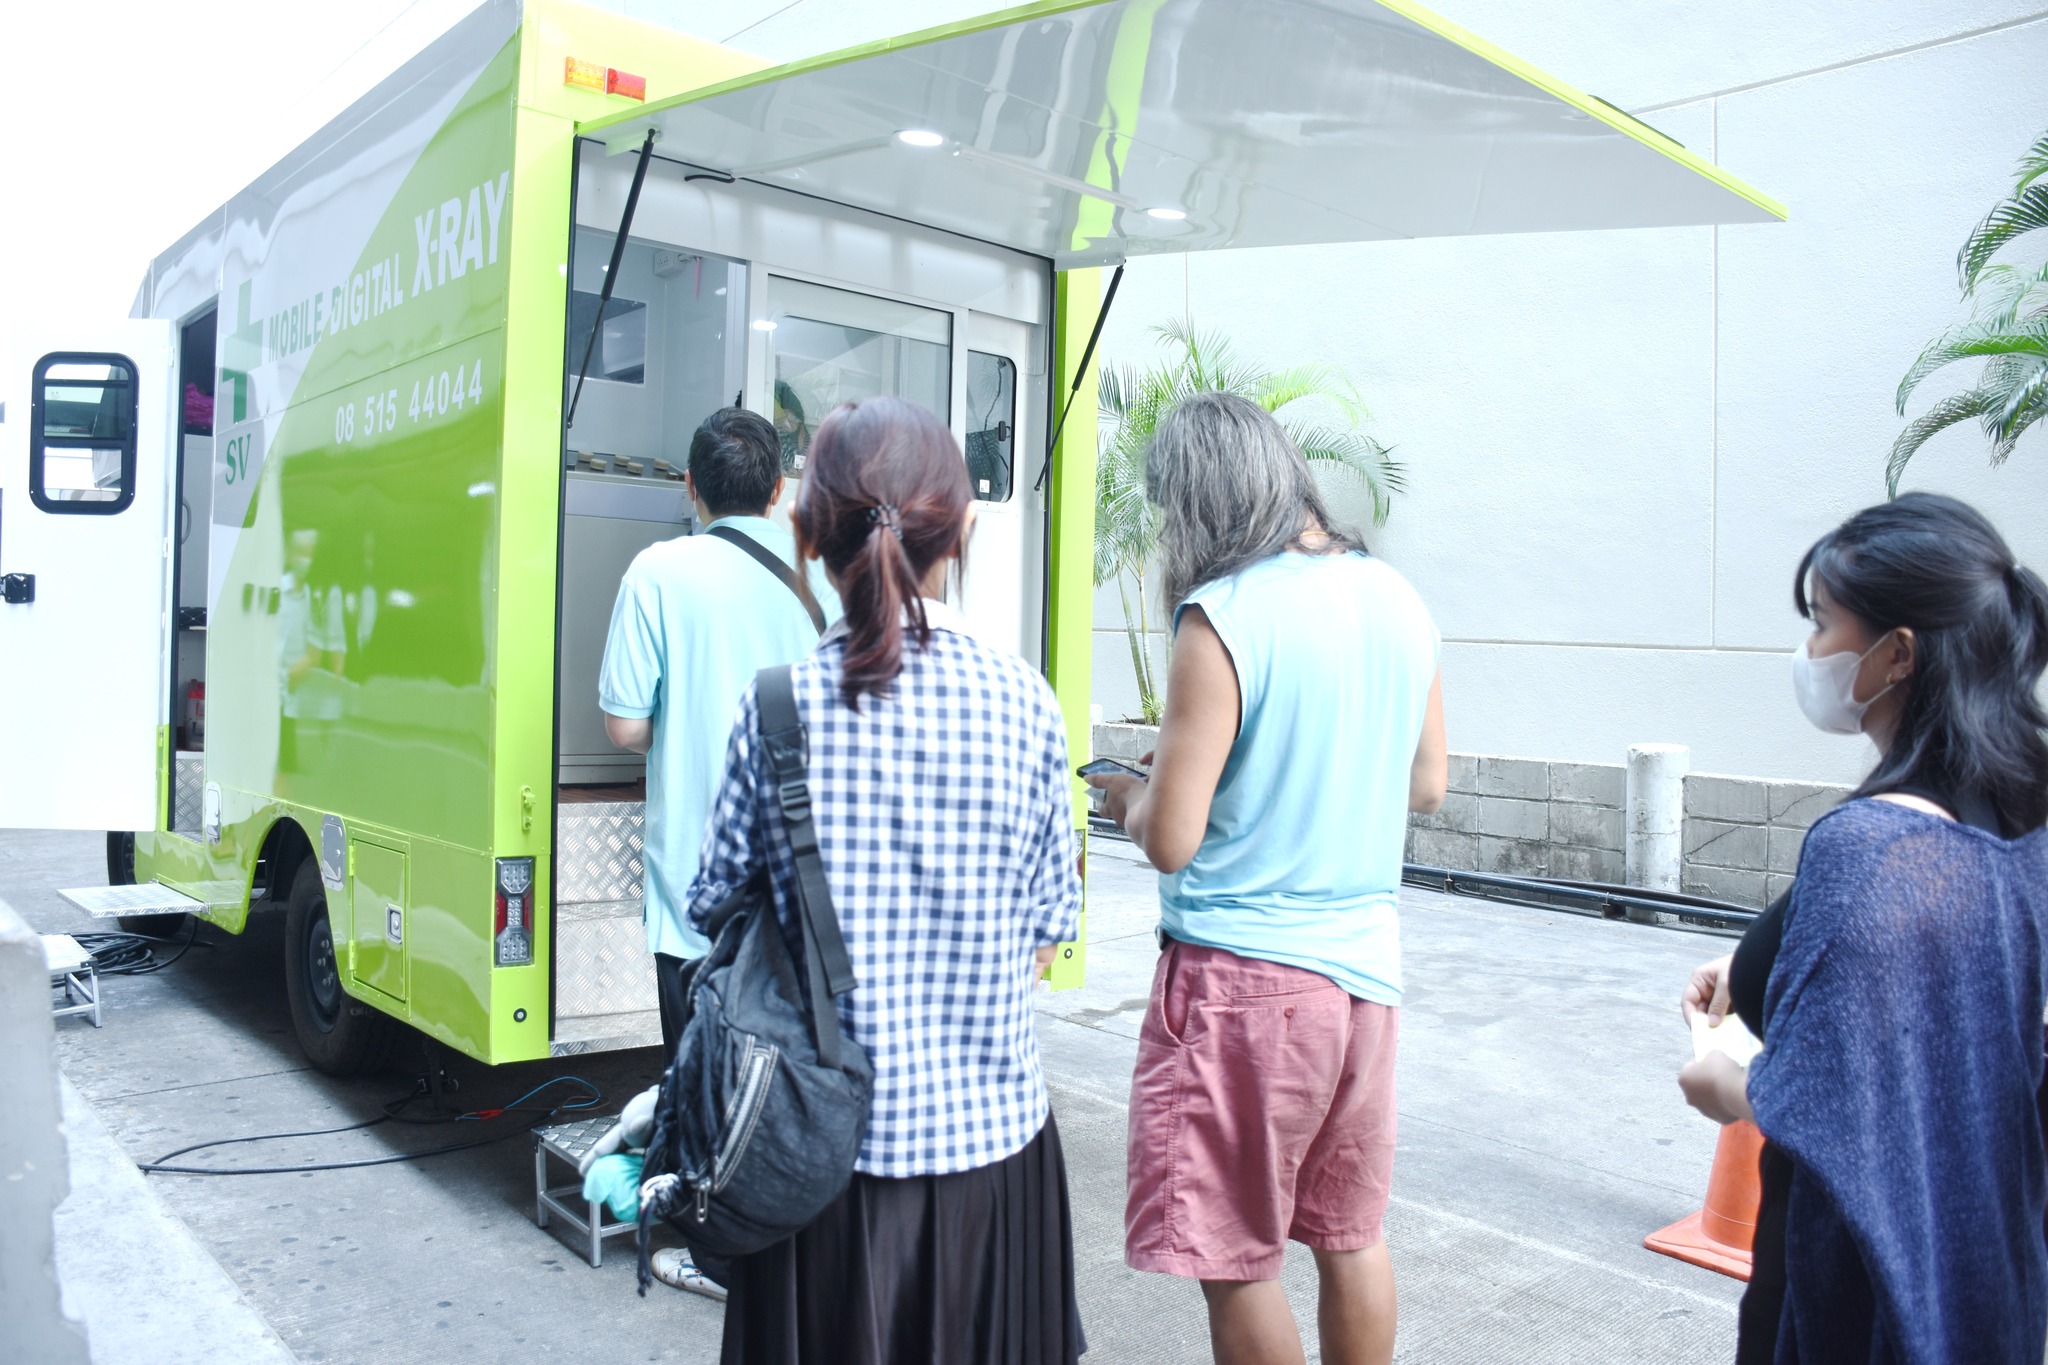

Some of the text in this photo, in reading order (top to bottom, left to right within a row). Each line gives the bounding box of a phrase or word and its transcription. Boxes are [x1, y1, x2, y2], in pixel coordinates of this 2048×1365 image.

[269, 171, 510, 362] MOBILE DIGITAL X-RAY
[335, 358, 483, 444] 08 515 44044
[226, 433, 251, 485] SV
